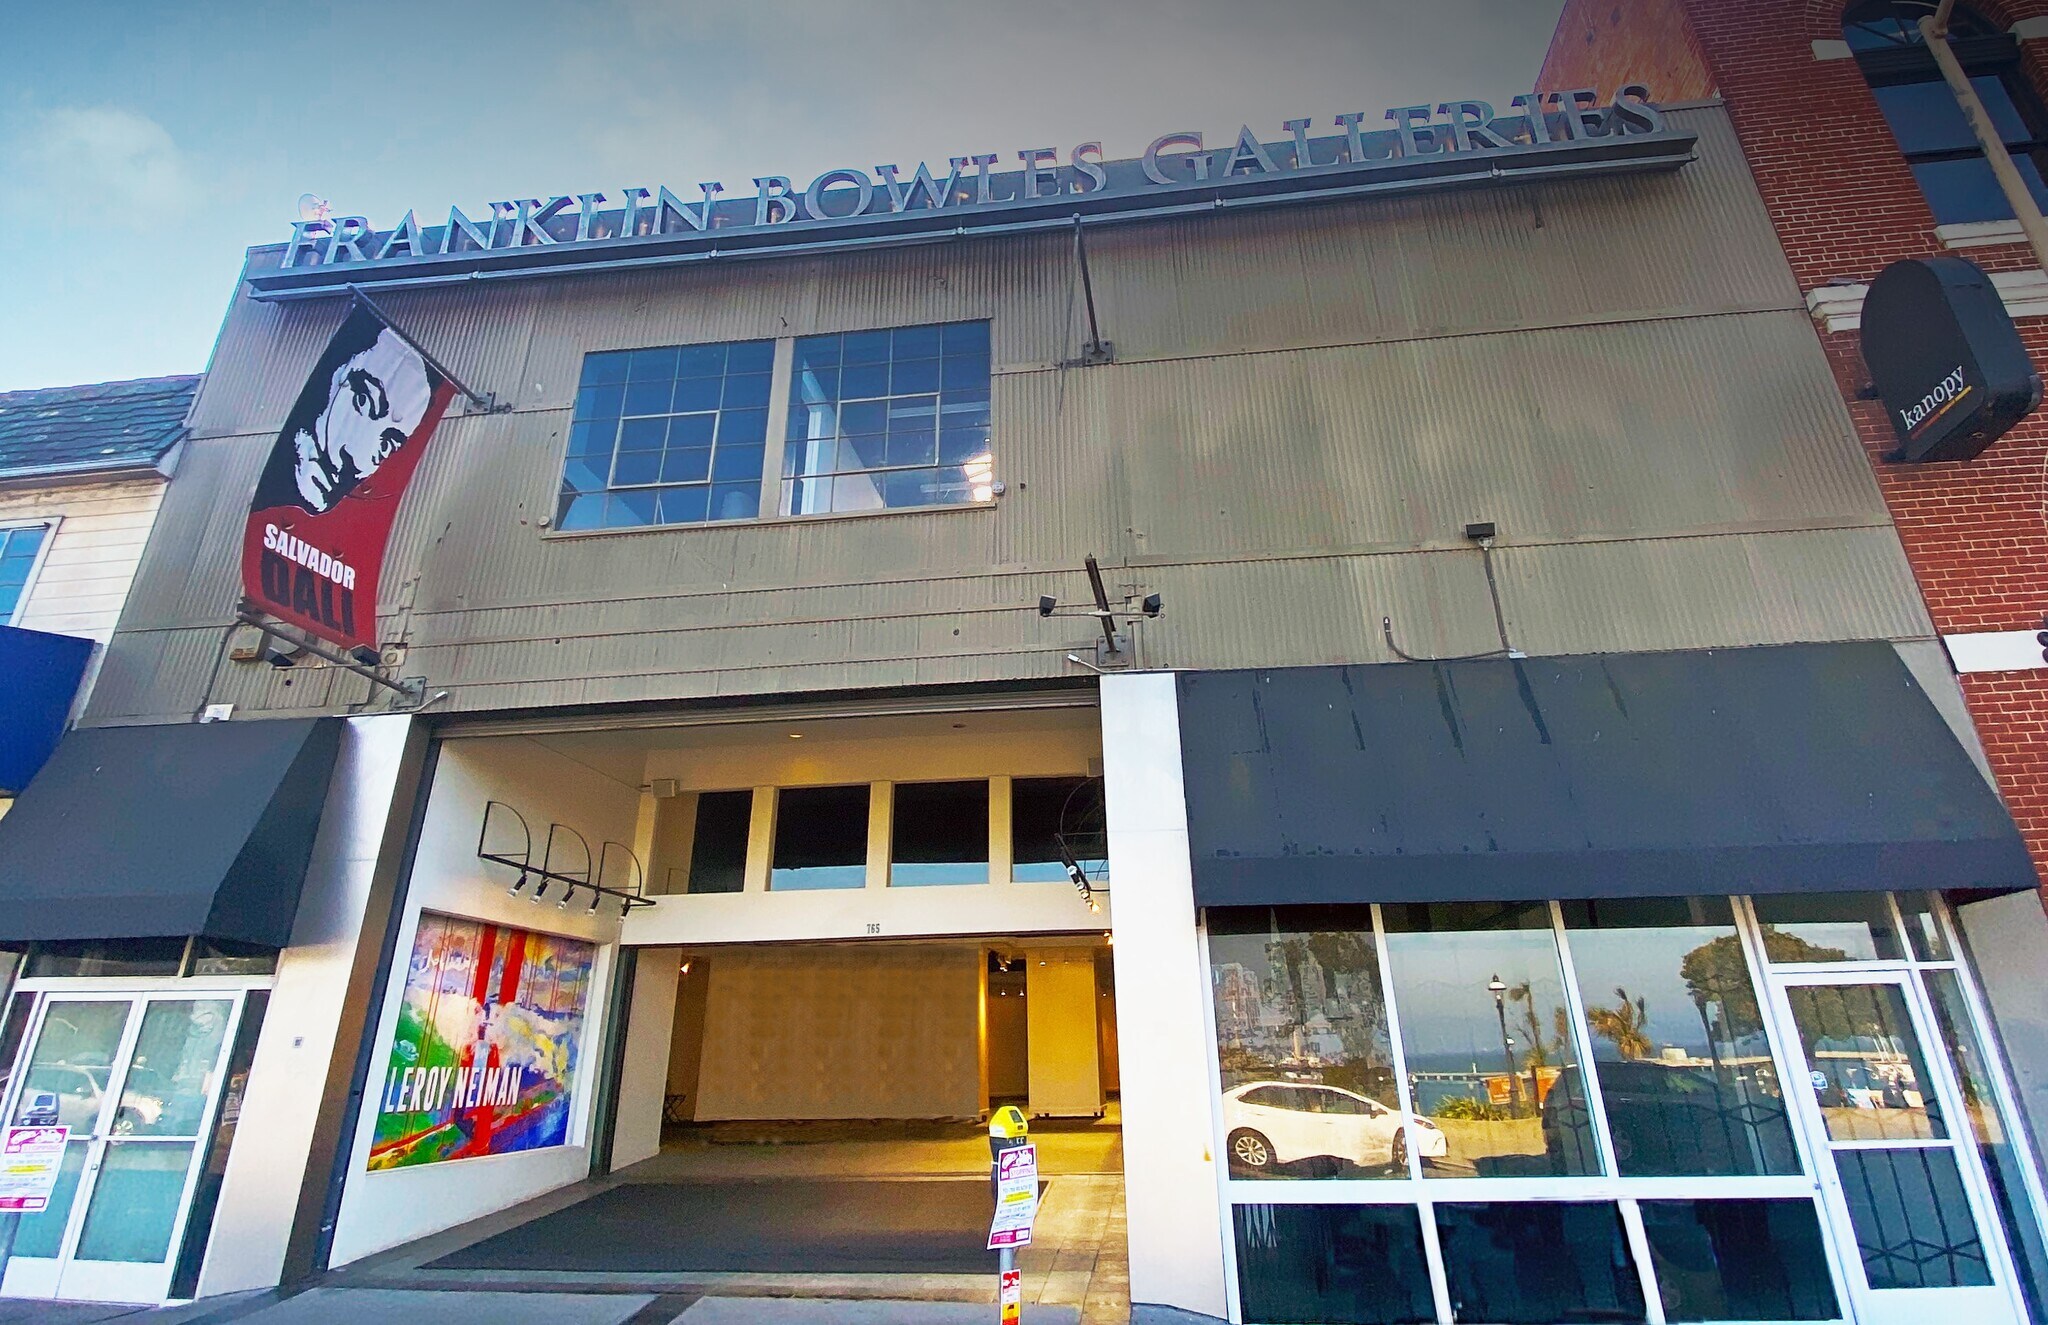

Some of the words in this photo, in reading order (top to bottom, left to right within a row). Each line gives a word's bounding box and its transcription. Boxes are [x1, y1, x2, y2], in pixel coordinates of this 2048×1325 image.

[281, 182, 724, 268] FRANKLIN
[752, 142, 1107, 226] BOWLES
[1142, 83, 1666, 184] GALLERIES
[1900, 365, 1964, 431] kanopy
[263, 524, 356, 590] SALVADOR
[263, 550, 354, 636] DALI
[866, 923, 880, 934] 765
[384, 1066, 453, 1113] LEROY
[451, 1066, 523, 1109] NEIMAN
